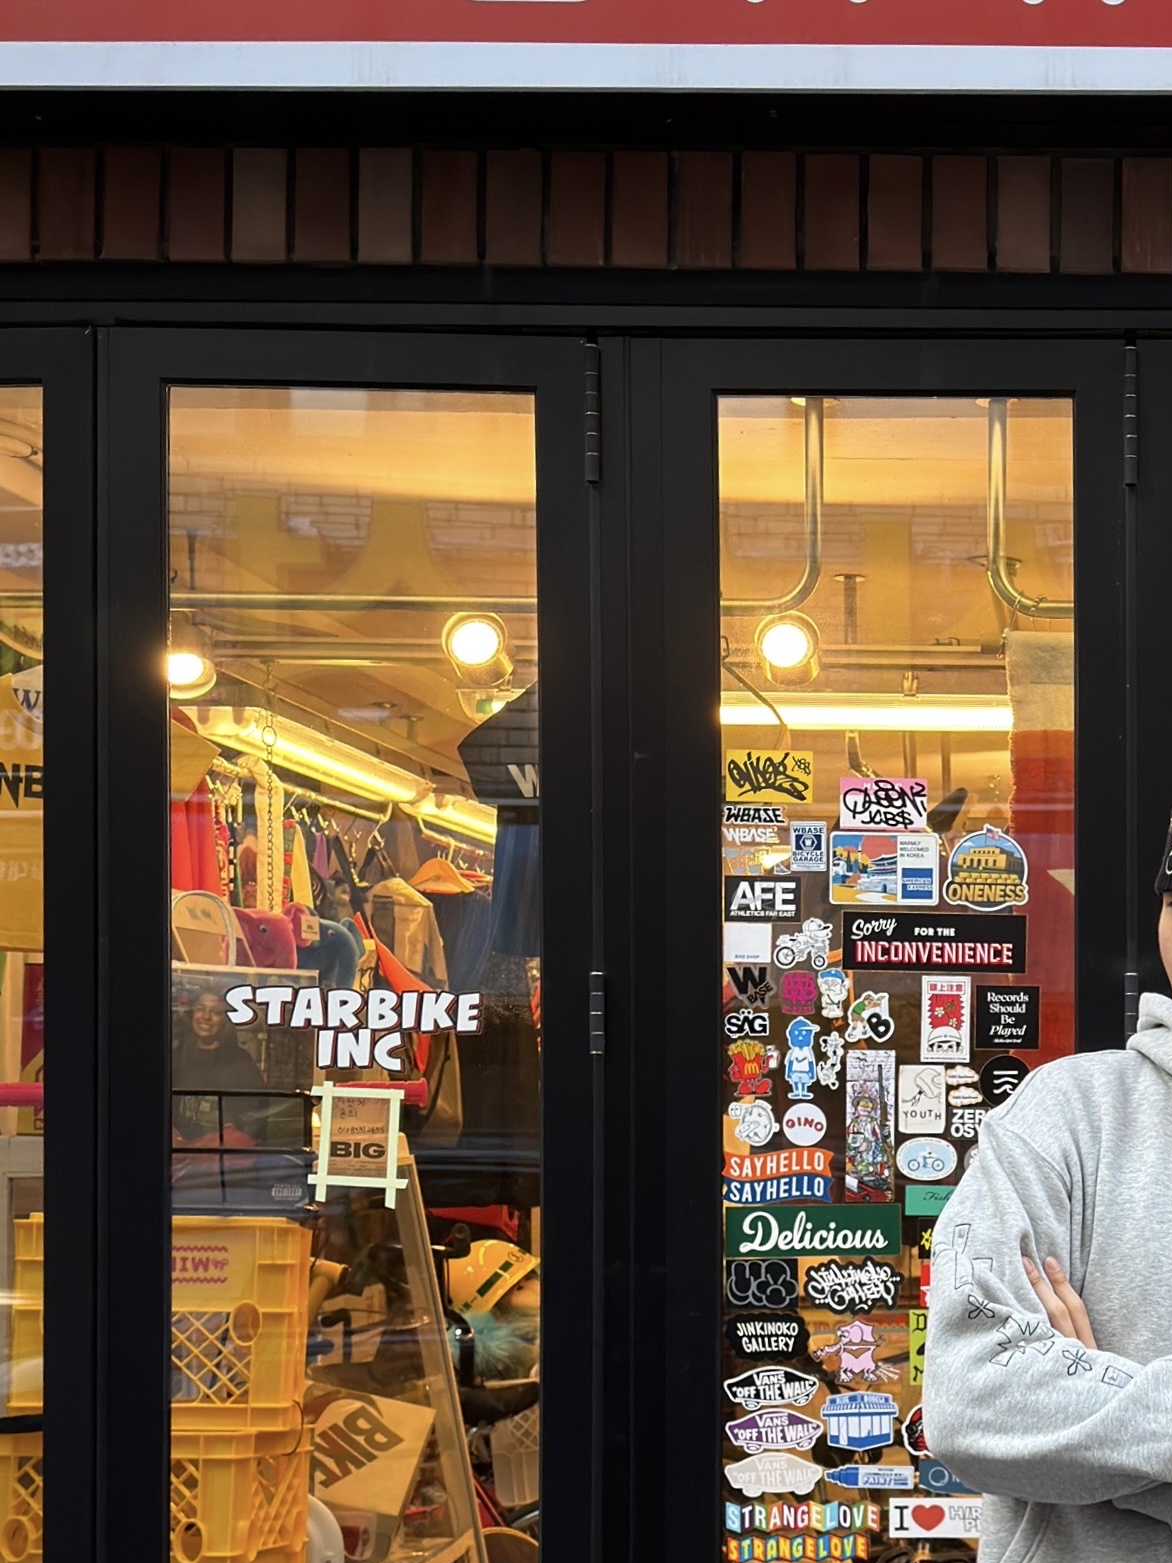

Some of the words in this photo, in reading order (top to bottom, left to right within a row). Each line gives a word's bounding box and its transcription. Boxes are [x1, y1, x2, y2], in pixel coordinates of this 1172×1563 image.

[725, 807, 785, 824] WBASE
[722, 827, 780, 846] WBASE
[730, 881, 797, 911] AFE
[949, 884, 1026, 902] ONENESS
[851, 917, 898, 940] Sorry
[914, 927, 935, 936] FOR
[936, 927, 956, 937] THE
[855, 941, 1014, 966] INCONVENIENCE
[987, 991, 1029, 1002] Records
[226, 985, 483, 1034] STARBIKE
[989, 1003, 1026, 1013] Should
[1001, 1014, 1016, 1024] Be
[989, 1025, 1027, 1037] Played
[317, 1029, 405, 1072] INC
[903, 1109, 942, 1120] YOUTH
[785, 1116, 824, 1132] GINO
[330, 1141, 386, 1159] BIG
[730, 1152, 824, 1177] SAYHELLO
[729, 1178, 824, 1202] SAYHELLO
[739, 1211, 888, 1251] Delicious
[737, 1321, 799, 1336] JINKINOKO
[742, 1336, 795, 1352] GALLERY
[753, 1371, 785, 1386] VANS
[758, 1385, 782, 1401] THE
[755, 1413, 789, 1427] VANS
[760, 1428, 784, 1444] THE
[754, 1457, 787, 1471] VANS
[758, 1471, 782, 1487] THE
[727, 1503, 880, 1532] STRANGELOVE
[894, 1505, 909, 1531] I
[728, 1535, 868, 1562] STRANGELOVE
